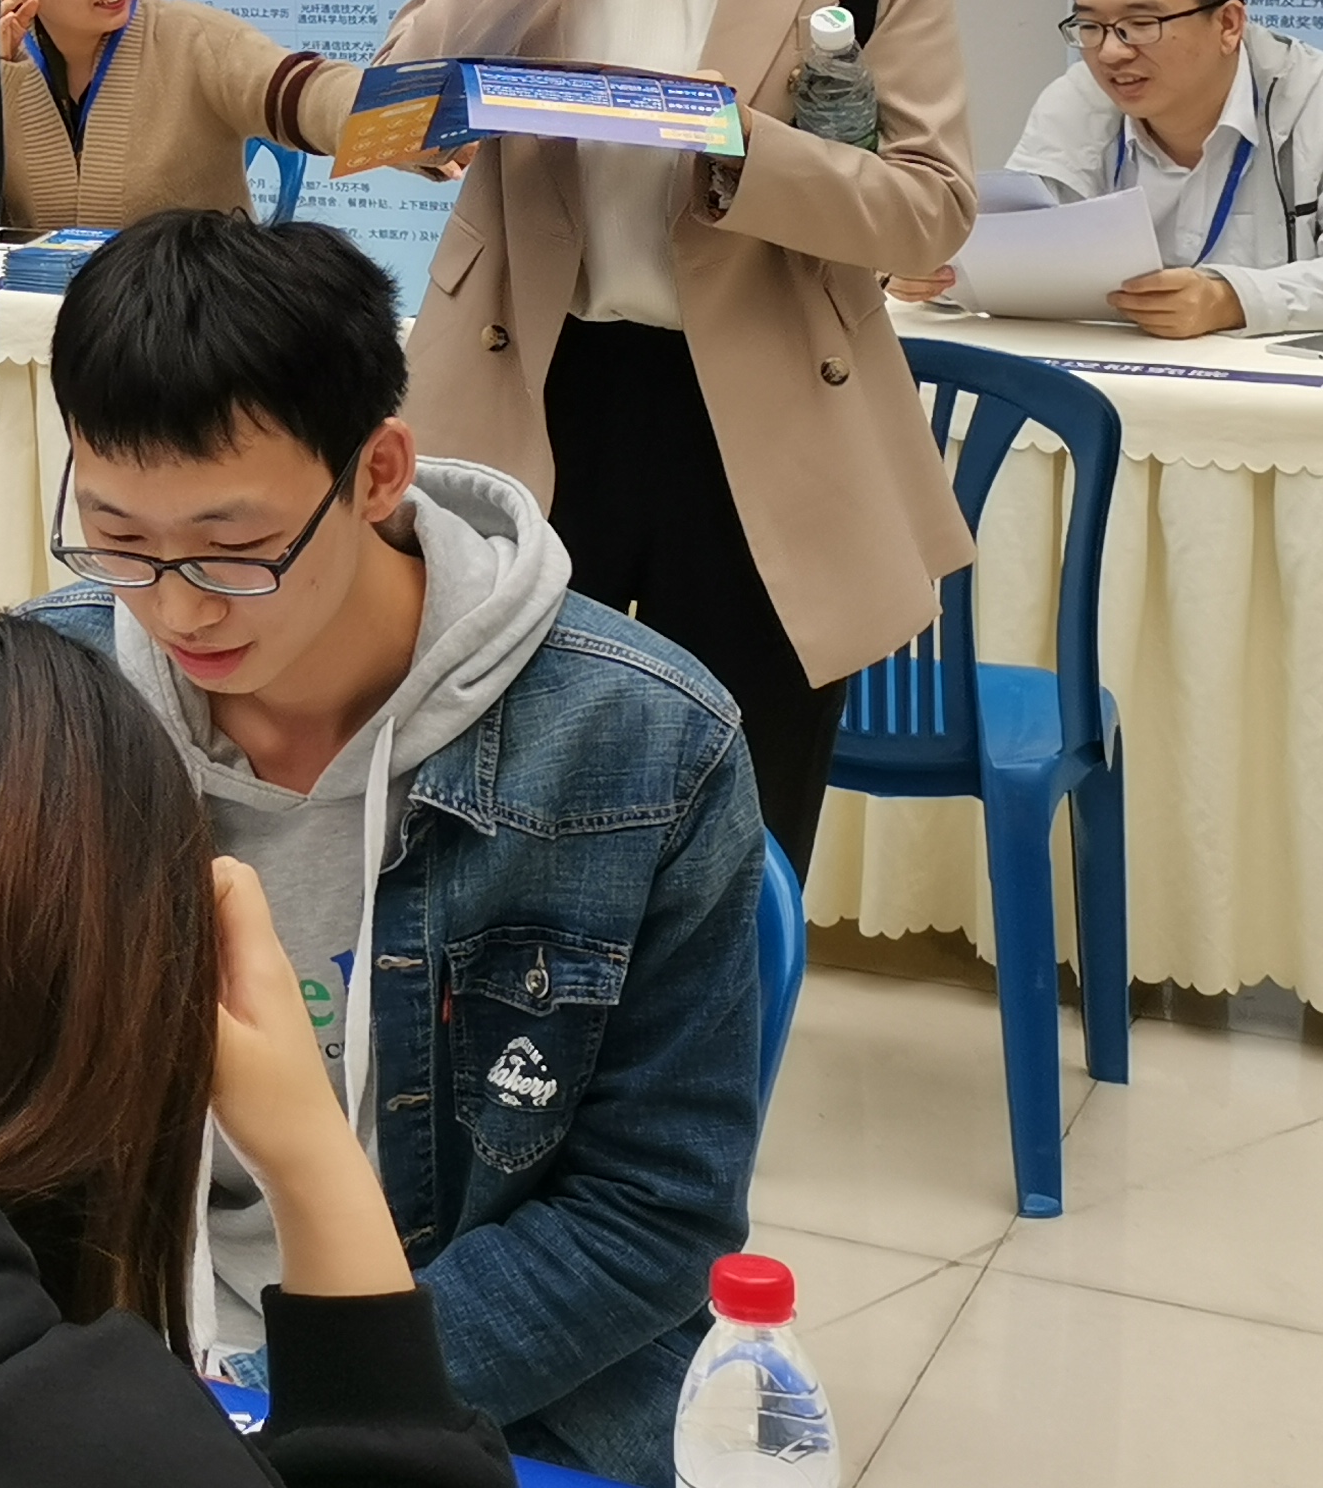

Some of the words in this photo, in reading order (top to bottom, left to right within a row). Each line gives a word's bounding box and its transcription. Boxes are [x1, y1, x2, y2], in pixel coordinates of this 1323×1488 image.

[223, 7, 290, 19] 科及以上学历
